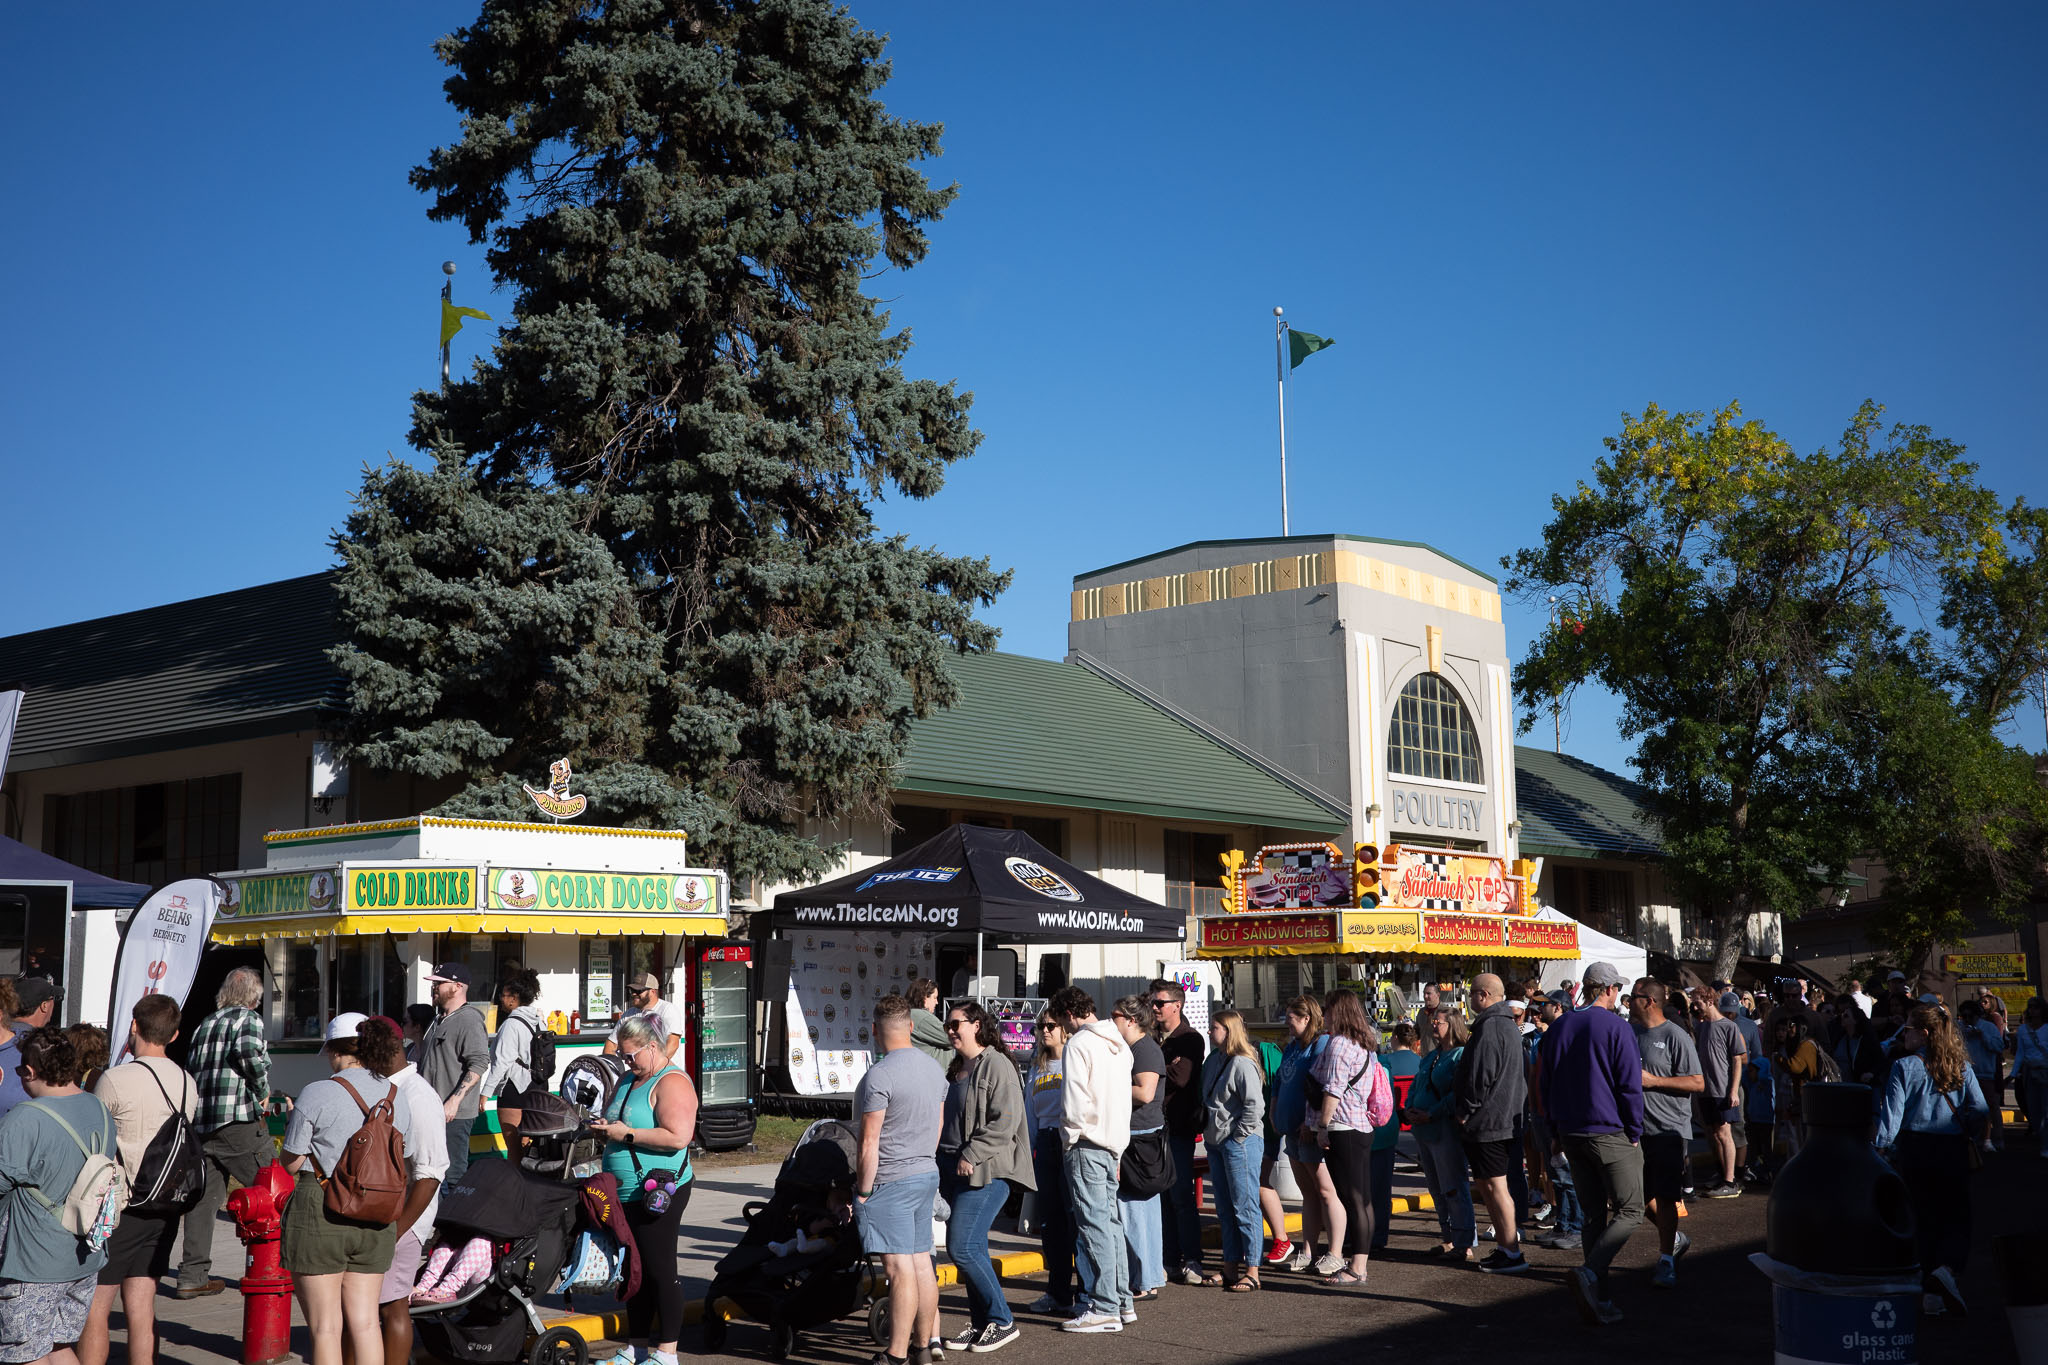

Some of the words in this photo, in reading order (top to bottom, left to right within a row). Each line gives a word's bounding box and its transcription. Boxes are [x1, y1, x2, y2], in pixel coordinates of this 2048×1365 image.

[540, 795, 567, 814] PONCHO
[567, 800, 582, 814] DOG
[1393, 789, 1483, 831] POULTRY
[875, 870, 914, 882] THE
[915, 870, 953, 881] ICE
[1280, 864, 1299, 873] The
[1414, 864, 1432, 879] The
[1270, 871, 1328, 886] Sandwich
[1401, 867, 1465, 899] Sandwich
[1467, 875, 1502, 902] STOP
[245, 880, 274, 914] CORN
[275, 876, 304, 912] DOGS
[356, 872, 399, 907] COLD
[404, 871, 470, 907] DRINKS
[545, 873, 606, 909] CORN
[611, 876, 668, 910] DOGS
[1279, 884, 1321, 902] STOP
[157, 907, 192, 927] BEANS
[795, 903, 959, 927] www.TheIceMN.org
[1038, 909, 1144, 933] www.KMOJFM.com
[152, 928, 187, 944] BEIGNETS
[1211, 928, 1238, 942] HOT
[1242, 924, 1330, 941] SANDWICHES
[1348, 924, 1375, 935] COLD
[1378, 923, 1417, 936] DRINKS
[1428, 926, 1456, 940] CUBAN
[1458, 927, 1499, 942] SANDWICH
[1526, 931, 1549, 944] MONTE
[1550, 933, 1574, 946] CRISTO
[1173, 971, 1201, 992] LOL
[1842, 1331, 1886, 1349] glass
[1862, 1346, 1906, 1364] plastic
